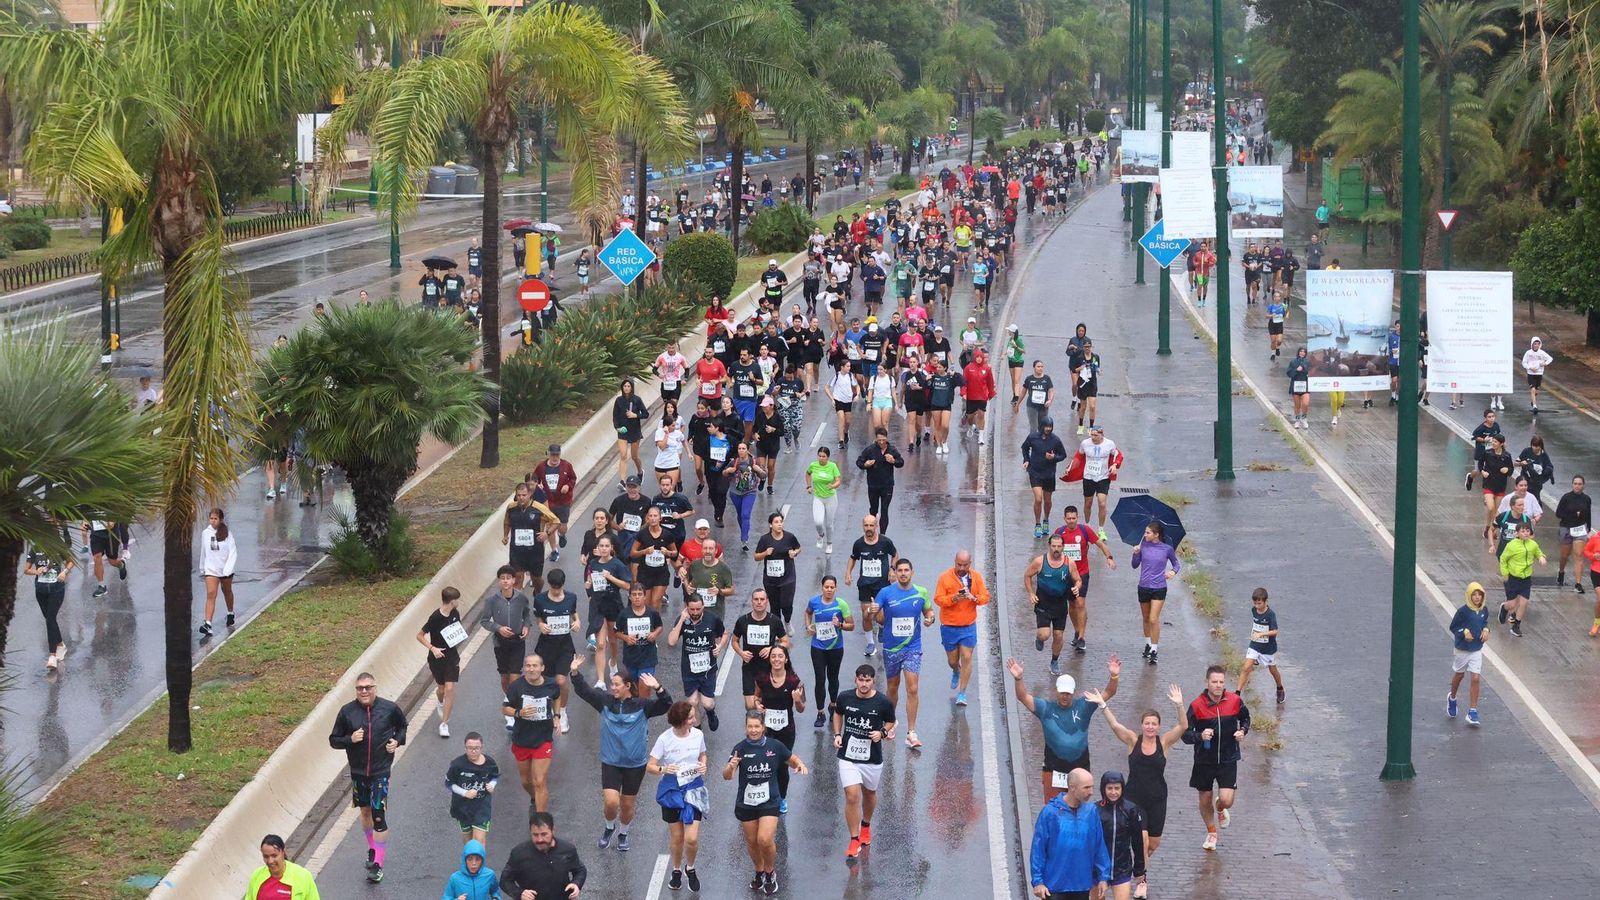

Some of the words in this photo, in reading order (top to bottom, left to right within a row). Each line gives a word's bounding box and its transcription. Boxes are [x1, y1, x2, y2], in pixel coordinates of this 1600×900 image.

[616, 248, 636, 256] RED
[608, 256, 644, 265] BASICA
[1321, 276, 1389, 286] WESTMORLAND
[850, 745, 867, 754] 6732
[747, 791, 766, 799] 6733
